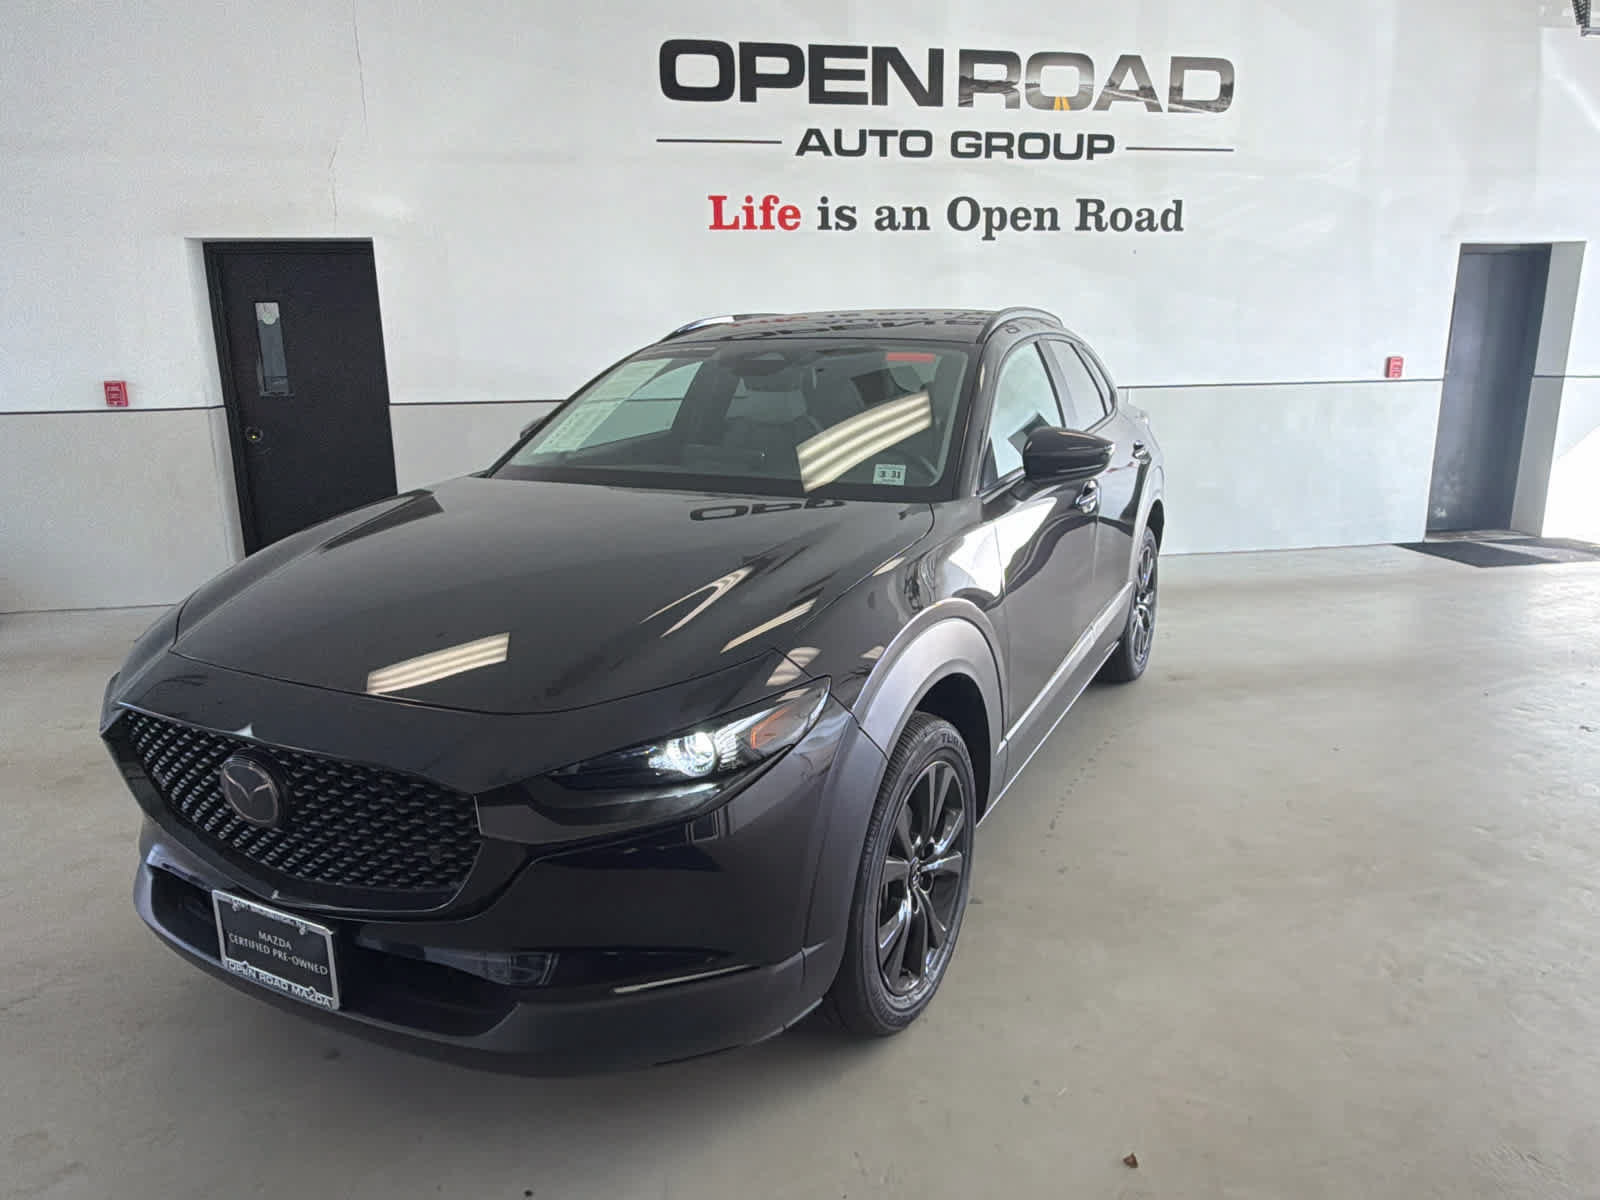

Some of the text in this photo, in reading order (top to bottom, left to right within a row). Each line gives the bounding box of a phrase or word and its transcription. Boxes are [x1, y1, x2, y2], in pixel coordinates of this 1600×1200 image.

[659, 39, 1235, 113] OPEN ROAD
[795, 128, 1116, 161] AUTO GROUP
[707, 194, 1185, 241] Life is an Open Road
[228, 932, 329, 976] CERTIFIED PRE-OWNED
[258, 930, 292, 951] MAZDA
[258, 972, 289, 992] ROAD
[292, 982, 331, 1007] MAZDA
